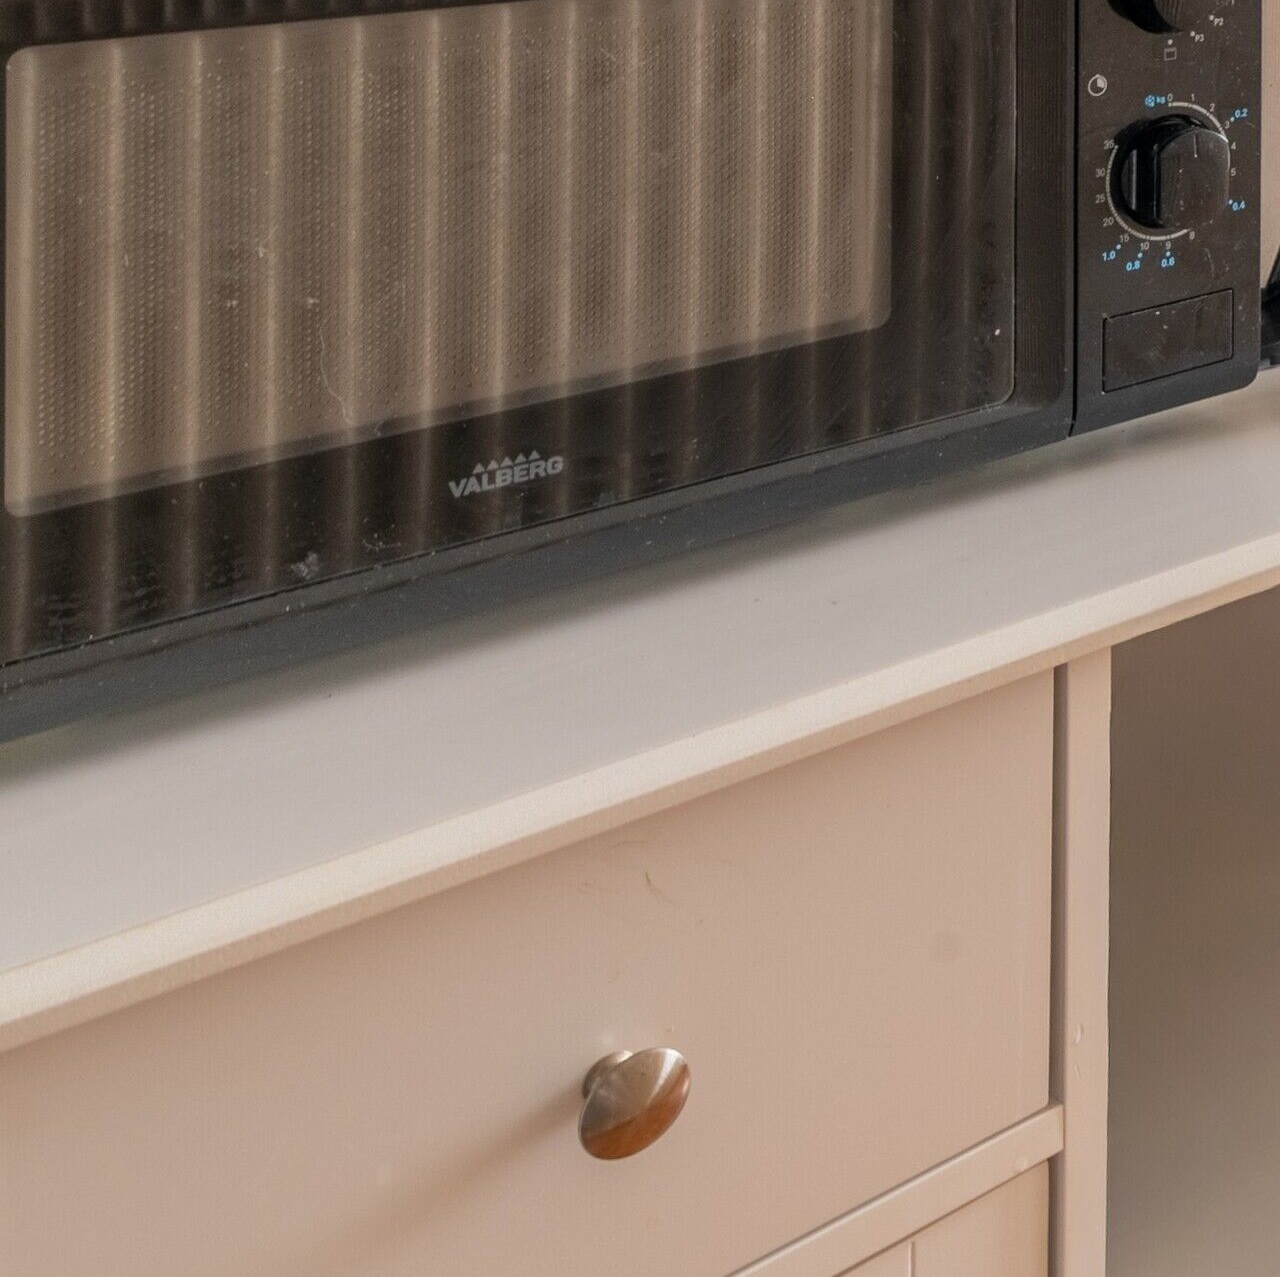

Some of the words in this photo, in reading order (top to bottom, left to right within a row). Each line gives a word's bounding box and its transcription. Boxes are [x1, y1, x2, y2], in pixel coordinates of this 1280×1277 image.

[1167, 93, 1174, 102] 0
[1209, 103, 1216, 111] 2
[1235, 108, 1248, 119] 0.2
[1095, 168, 1106, 177] 30
[1231, 168, 1237, 177] 5
[1095, 194, 1106, 204] 25
[1232, 200, 1246, 211] 0.4
[1103, 217, 1115, 227] 20
[1120, 233, 1130, 243] 15
[1140, 241, 1150, 250] 10
[1166, 241, 1172, 250] 9
[1102, 251, 1116, 262] 1.0
[1126, 260, 1141, 271] 0.8
[1161, 256, 1176, 268] 0.6
[448, 455, 564, 498] VALBERG
